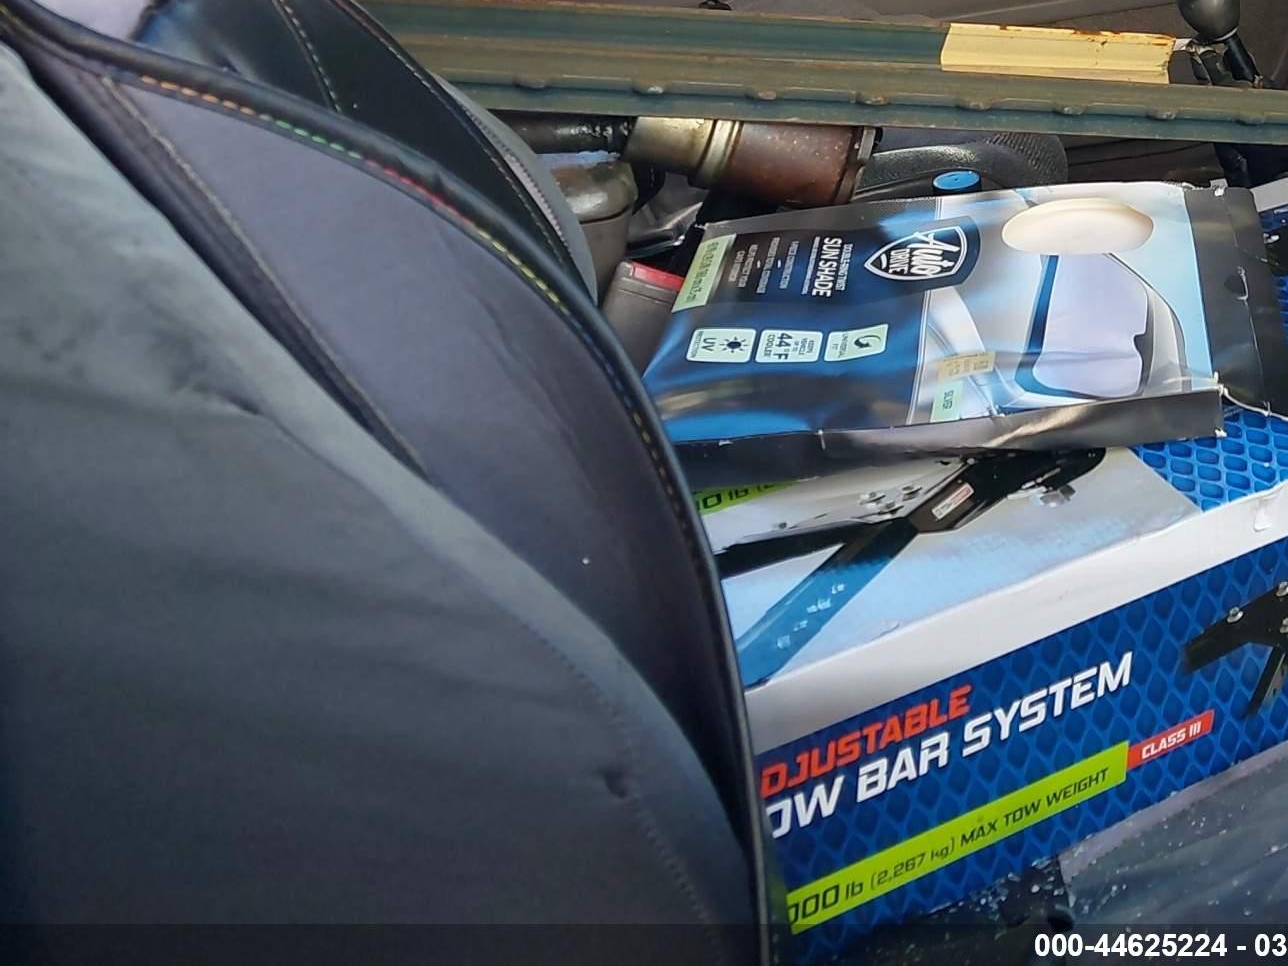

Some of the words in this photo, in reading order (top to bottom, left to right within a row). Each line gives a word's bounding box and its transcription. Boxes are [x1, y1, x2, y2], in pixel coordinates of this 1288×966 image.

[822, 237, 842, 260] SUN
[888, 248, 910, 274] DRIVE
[907, 232, 960, 276] Auto
[812, 260, 838, 298] SHADE
[700, 337, 716, 352] UV
[764, 334, 776, 358] COOLER
[761, 684, 973, 800] DJUSTABLE
[765, 775, 845, 840] OW
[856, 730, 950, 804] BAR
[962, 651, 1133, 758] SYSTEM
[1140, 730, 1188, 760] CLASS
[1188, 722, 1202, 742] III
[788, 884, 840, 926] 000
[845, 881, 864, 900] lb
[870, 852, 926, 892] (2,267
[930, 835, 956, 867] kg)
[959, 818, 999, 848] MAX
[1003, 799, 1042, 827] TOW
[1046, 767, 1109, 805] WEIGHT
